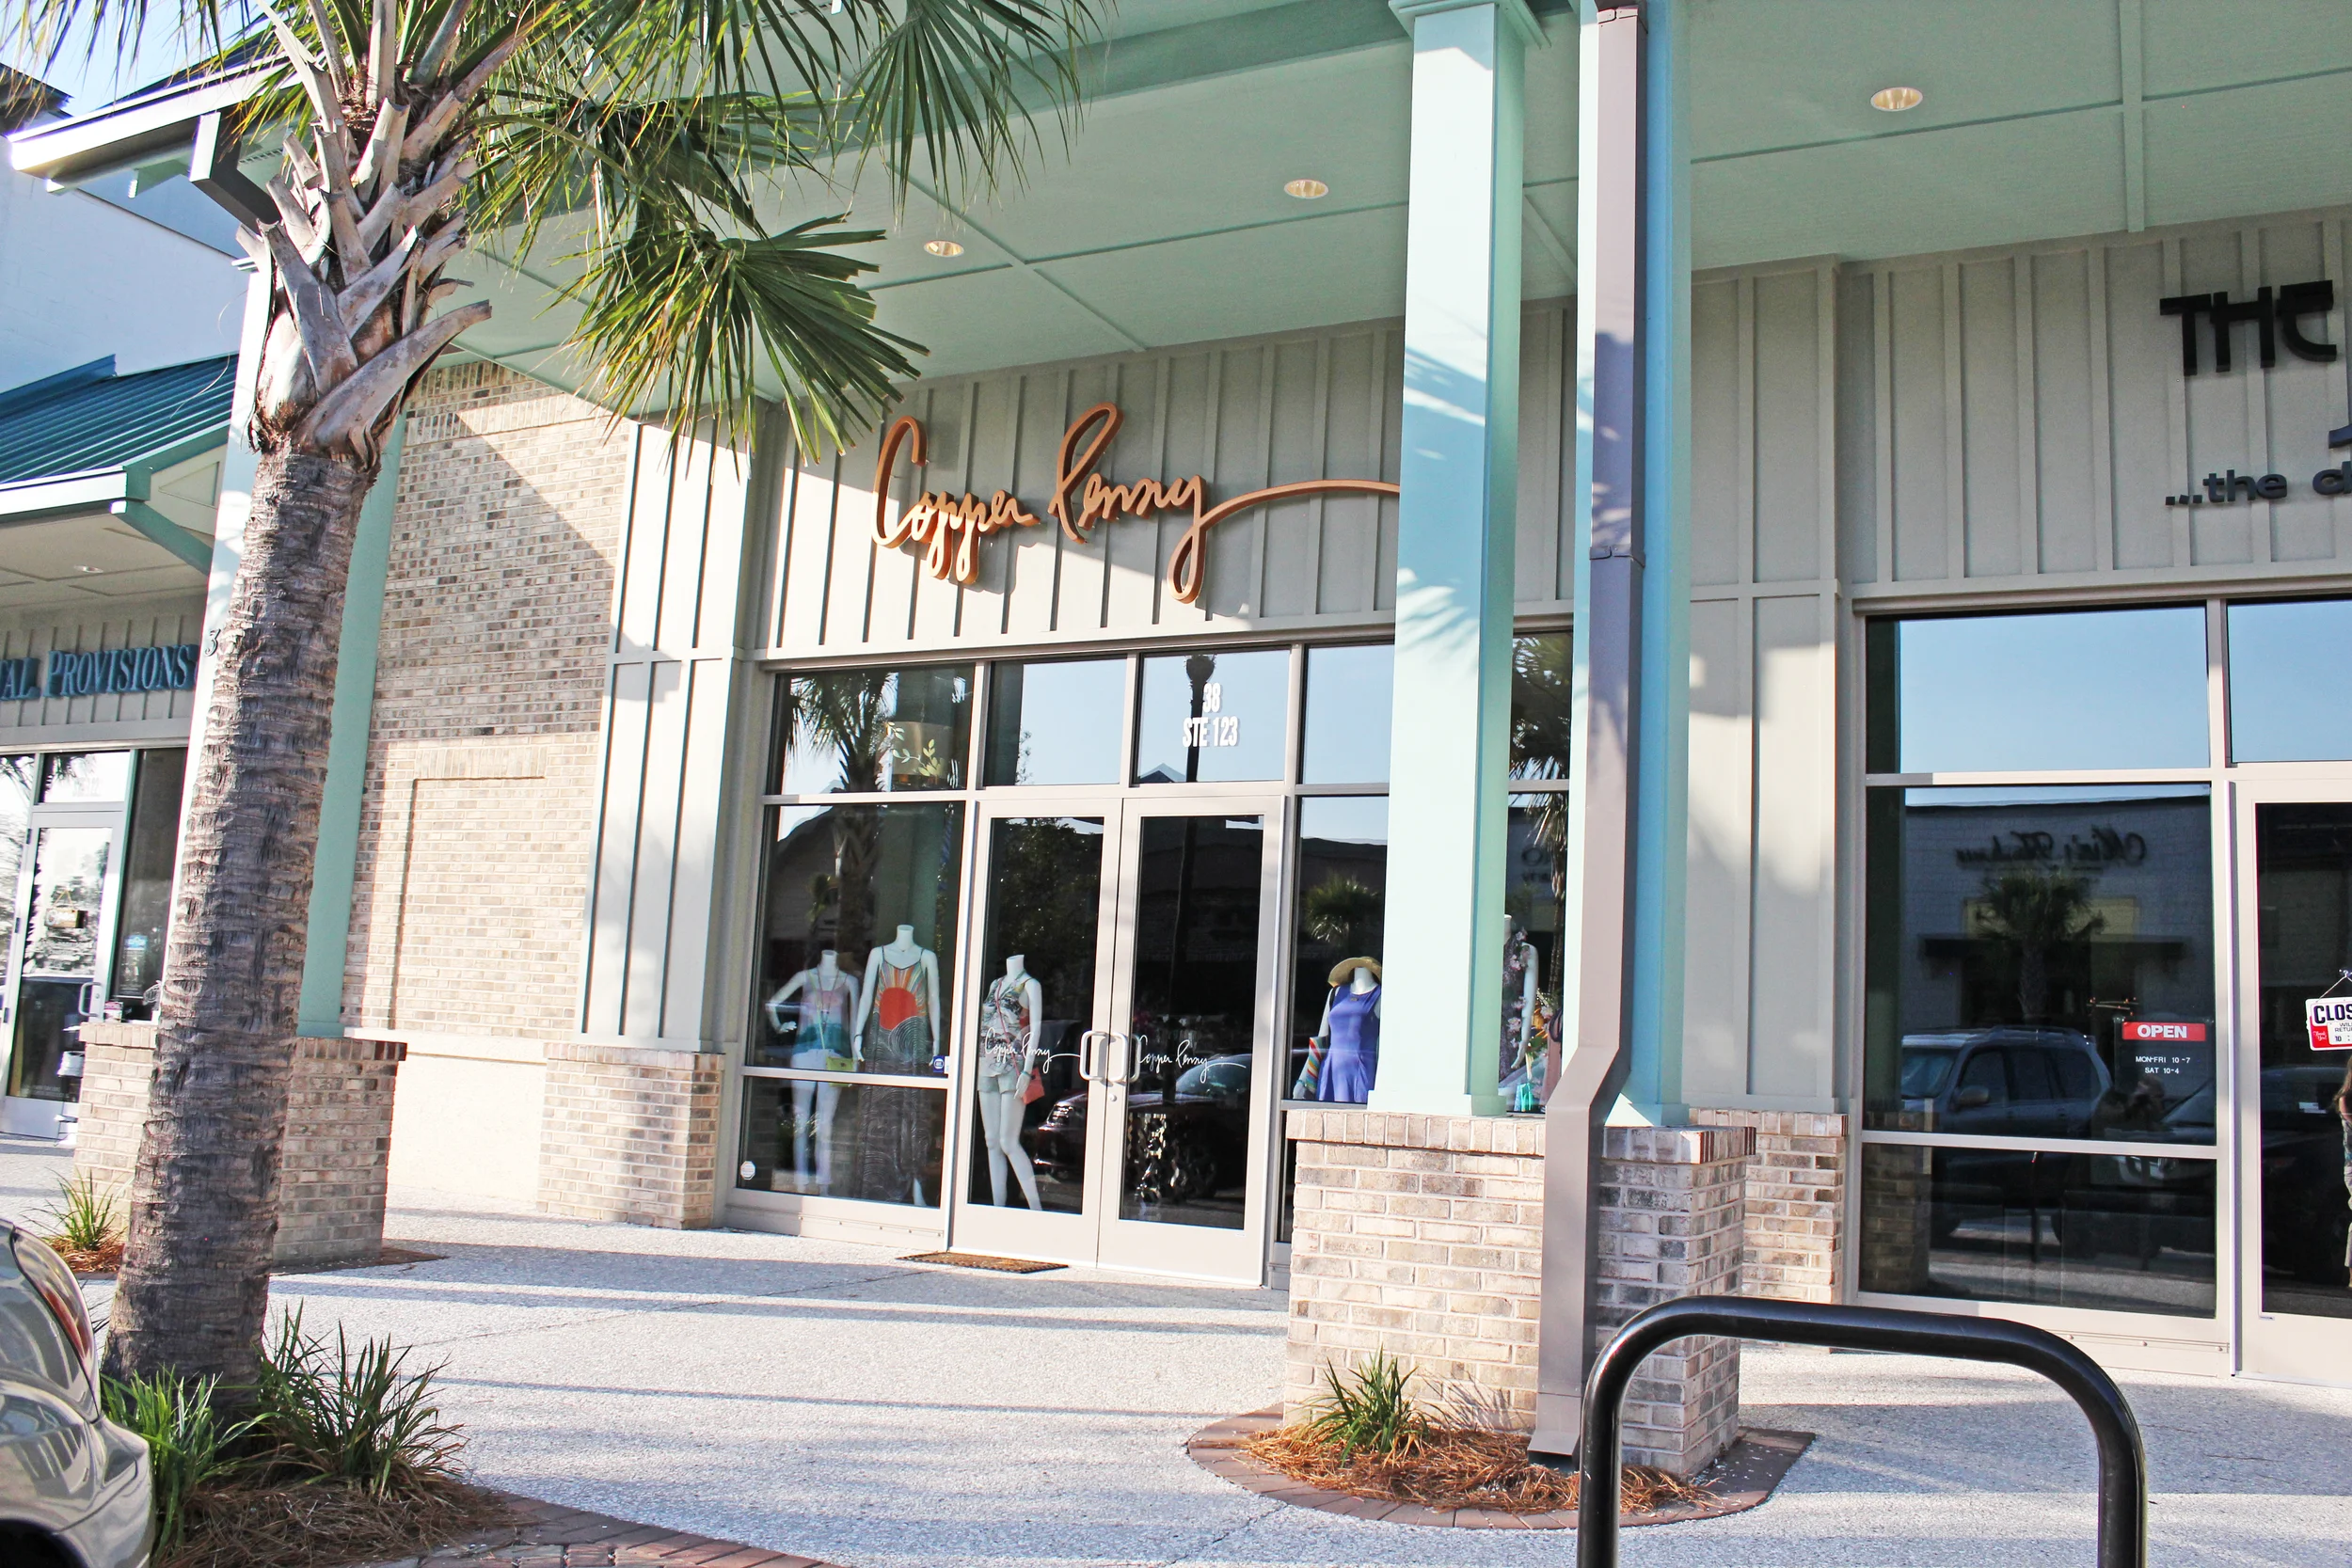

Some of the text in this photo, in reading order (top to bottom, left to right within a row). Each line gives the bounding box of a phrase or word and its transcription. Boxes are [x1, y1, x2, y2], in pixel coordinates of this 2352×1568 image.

[871, 415, 1041, 585] Copper
[43, 644, 196, 698] PROVISIONS
[1202, 682, 1221, 713] 38
[1182, 716, 1239, 748] STE 123
[2137, 1024, 2187, 1038] OPEN
[1136, 1035, 1173, 1074] Copper
[2135, 1055, 2167, 1064] MON-FRI
